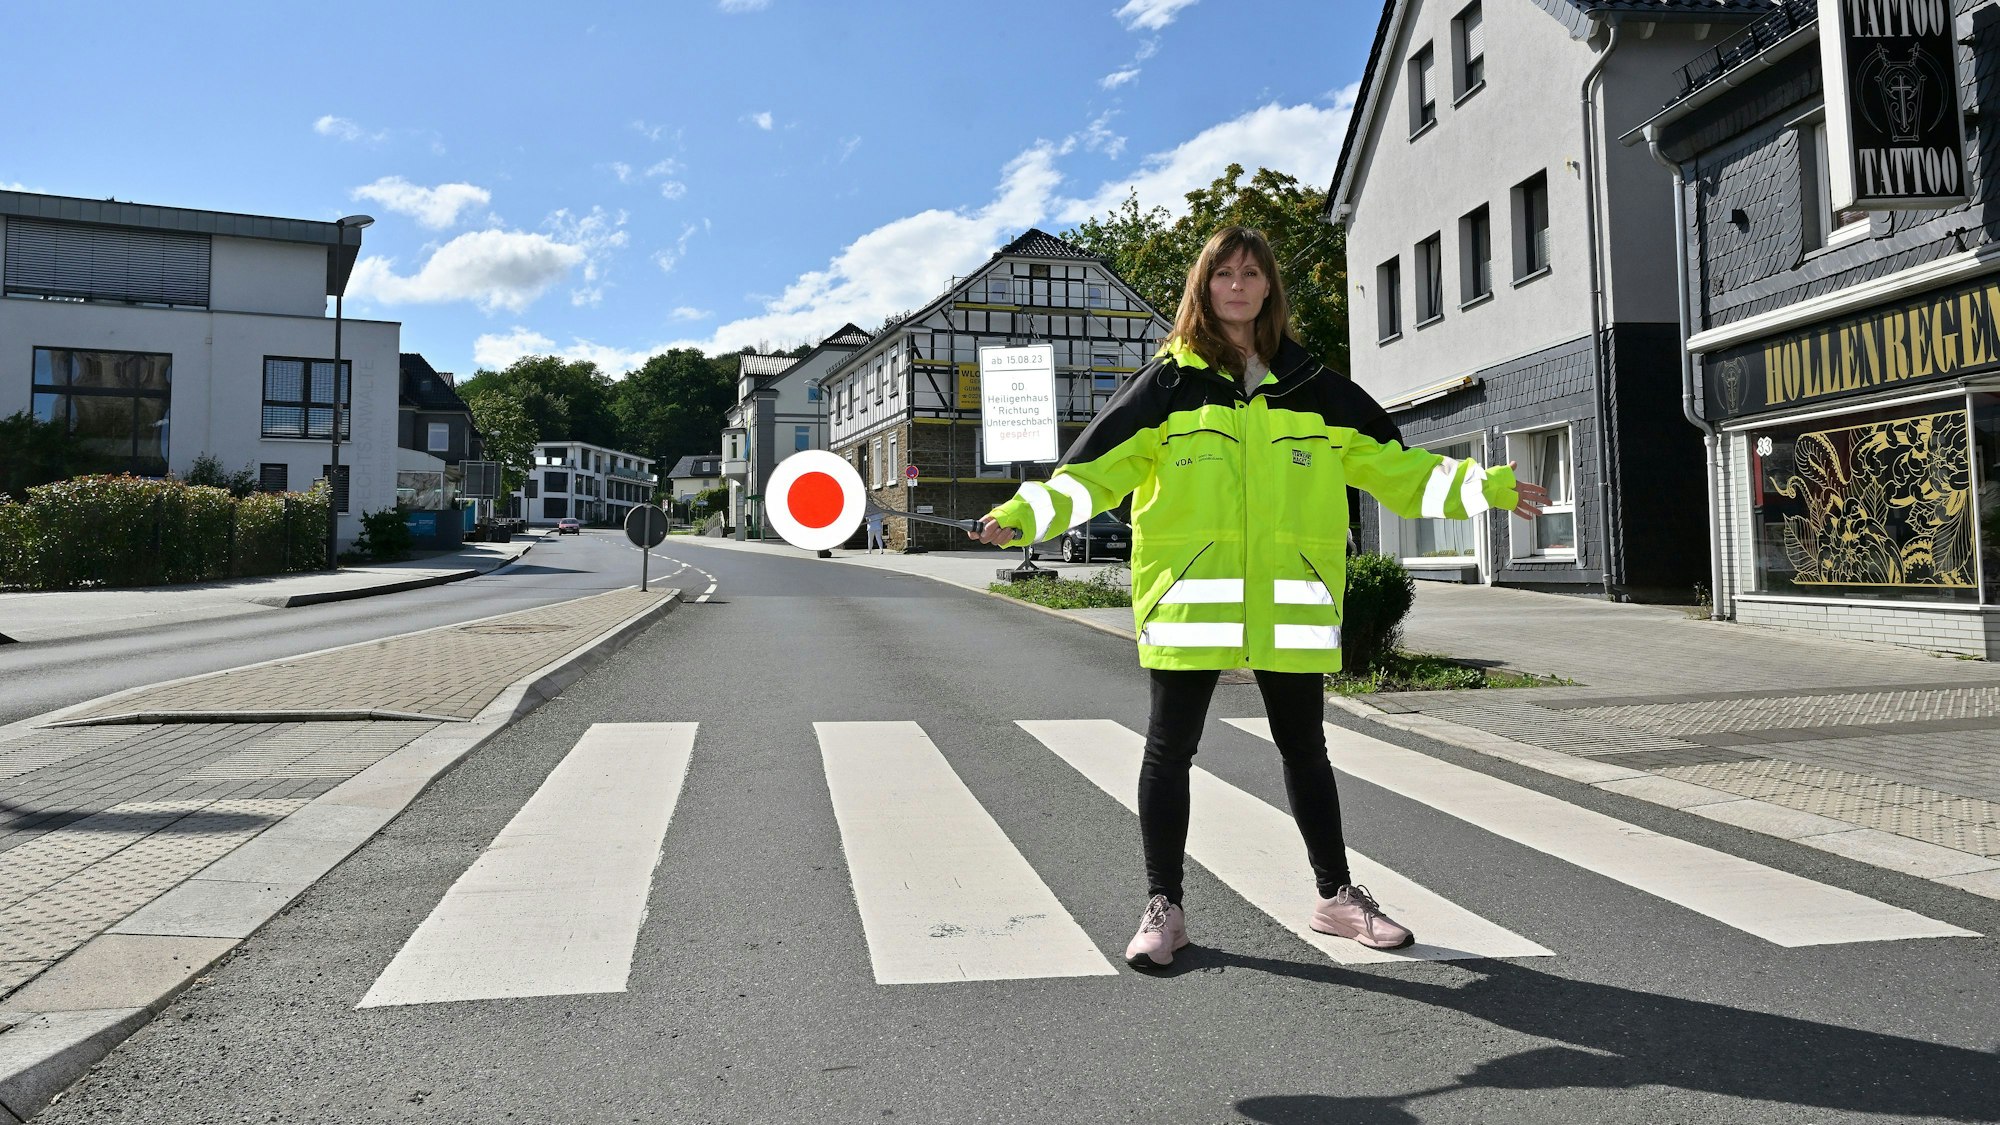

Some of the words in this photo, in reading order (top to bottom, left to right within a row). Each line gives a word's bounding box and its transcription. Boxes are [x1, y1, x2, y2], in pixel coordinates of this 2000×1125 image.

[1847, 0, 1945, 38] TATTOO
[1859, 146, 1958, 197] TATTOO
[991, 356, 1003, 365] ab
[1006, 354, 1043, 364] 15.08.23
[1011, 382, 1025, 391] OD
[987, 394, 1049, 405] Heiligenhaus
[998, 406, 1040, 416] Richtung
[986, 416, 1053, 427] Untereschbach
[999, 430, 1040, 441] gesperrt
